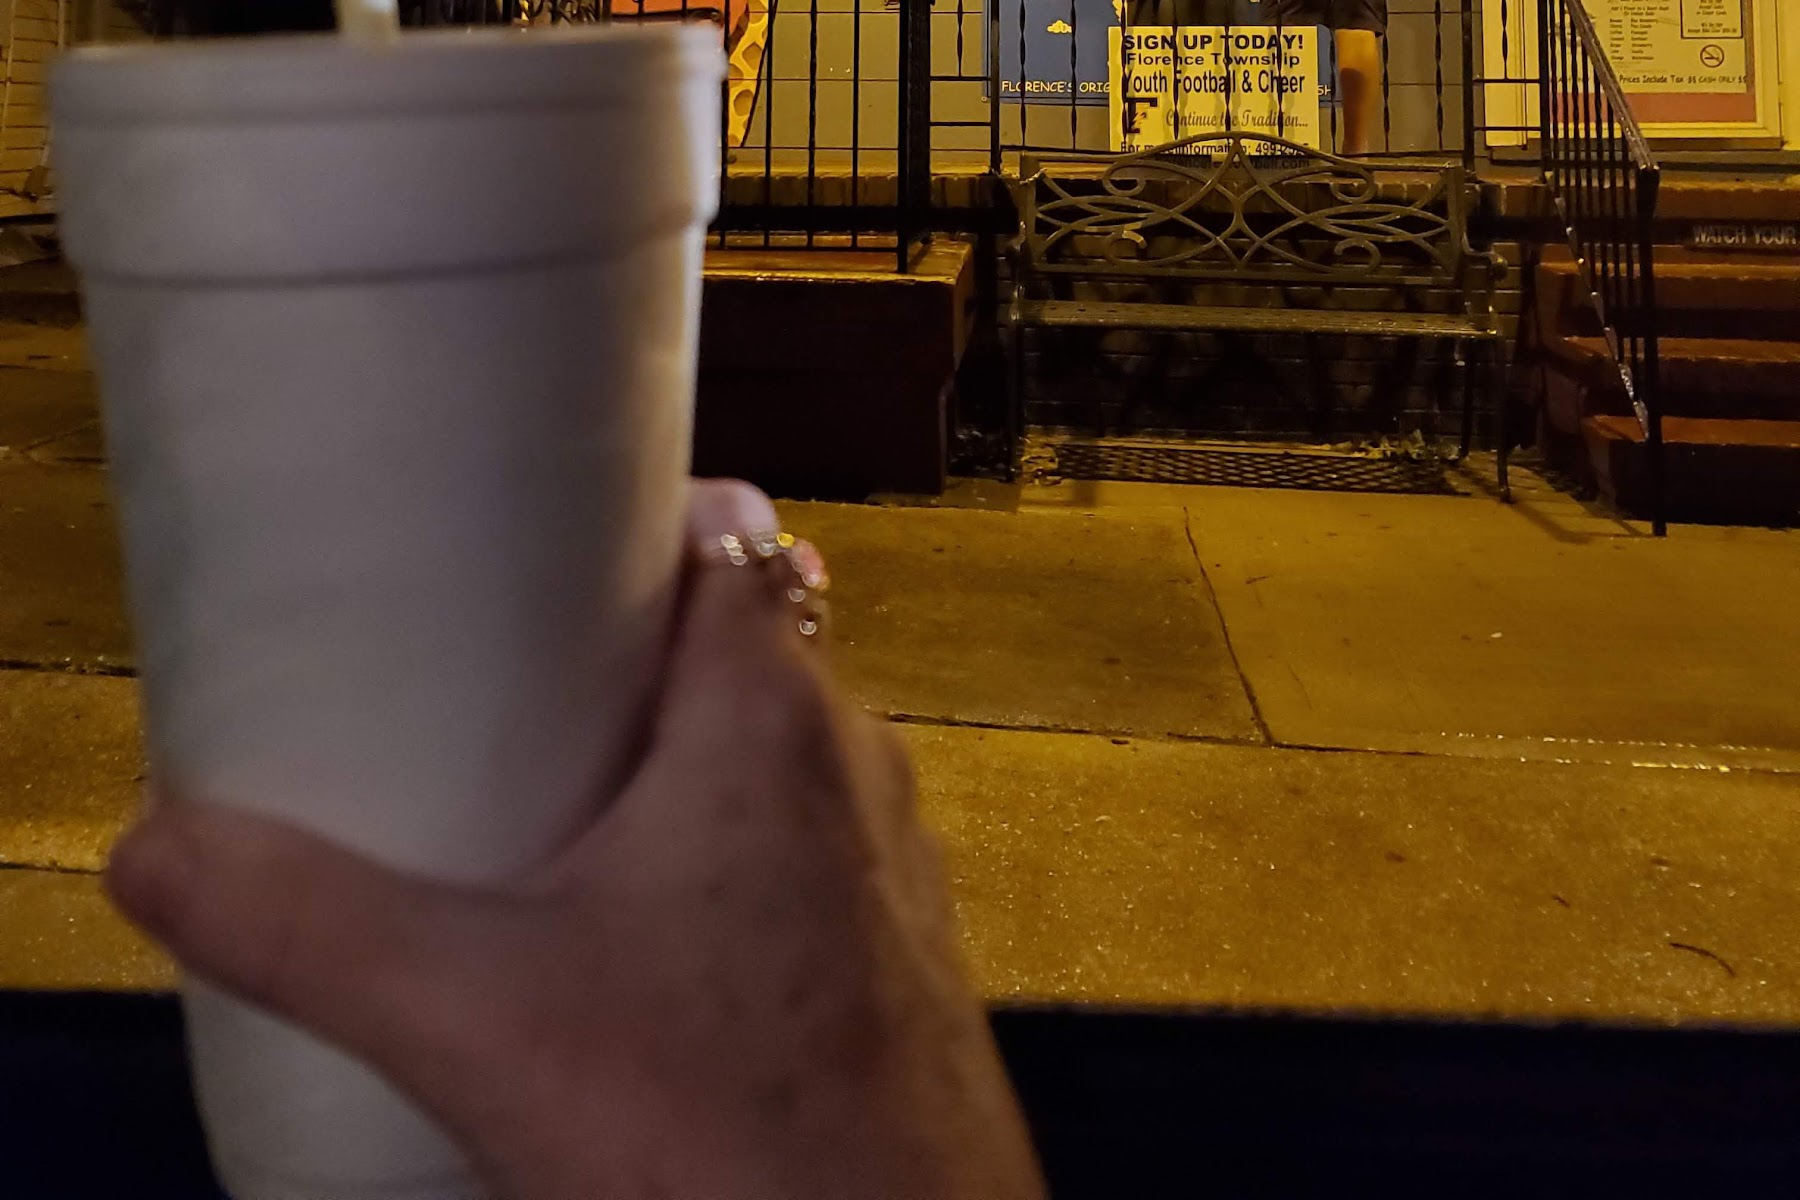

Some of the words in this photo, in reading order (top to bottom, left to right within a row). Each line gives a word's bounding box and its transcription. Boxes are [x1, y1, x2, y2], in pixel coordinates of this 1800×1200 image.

[1123, 34, 1175, 50] SIGN
[1183, 35, 1213, 50] UP
[1220, 34, 1304, 50] TODAY!
[1126, 53, 1204, 66] Florence
[1211, 53, 1300, 68] Township
[1079, 81, 1110, 93] ORIG
[1124, 69, 1168, 93] Youth
[1174, 69, 1236, 94] Football
[1241, 74, 1253, 93] &
[1257, 69, 1306, 94] Cheer
[1166, 109, 1218, 128] Cntinue
[1692, 225, 1747, 244] WATCH
[1752, 225, 1797, 245] YOUR
